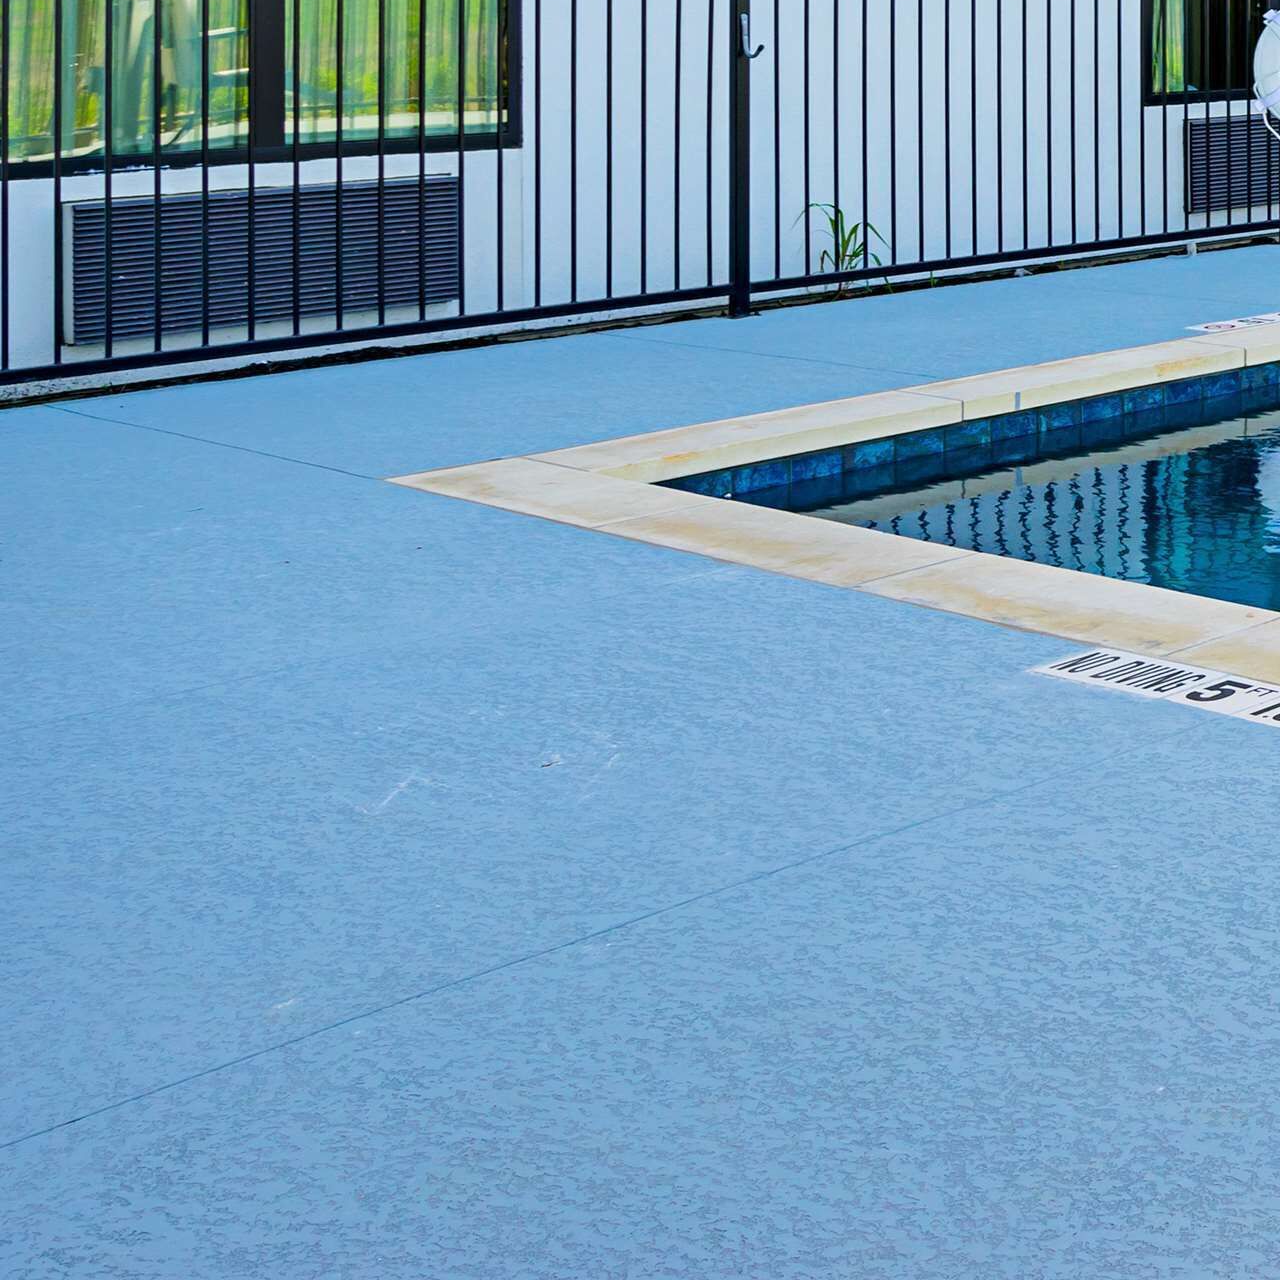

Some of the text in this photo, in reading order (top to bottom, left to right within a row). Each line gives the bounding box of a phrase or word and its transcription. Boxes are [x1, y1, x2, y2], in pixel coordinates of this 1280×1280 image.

[1049, 651, 1121, 673] NO
[1089, 660, 1206, 693] DIVING
[1185, 679, 1254, 702] 5
[1245, 686, 1279, 697] FT
